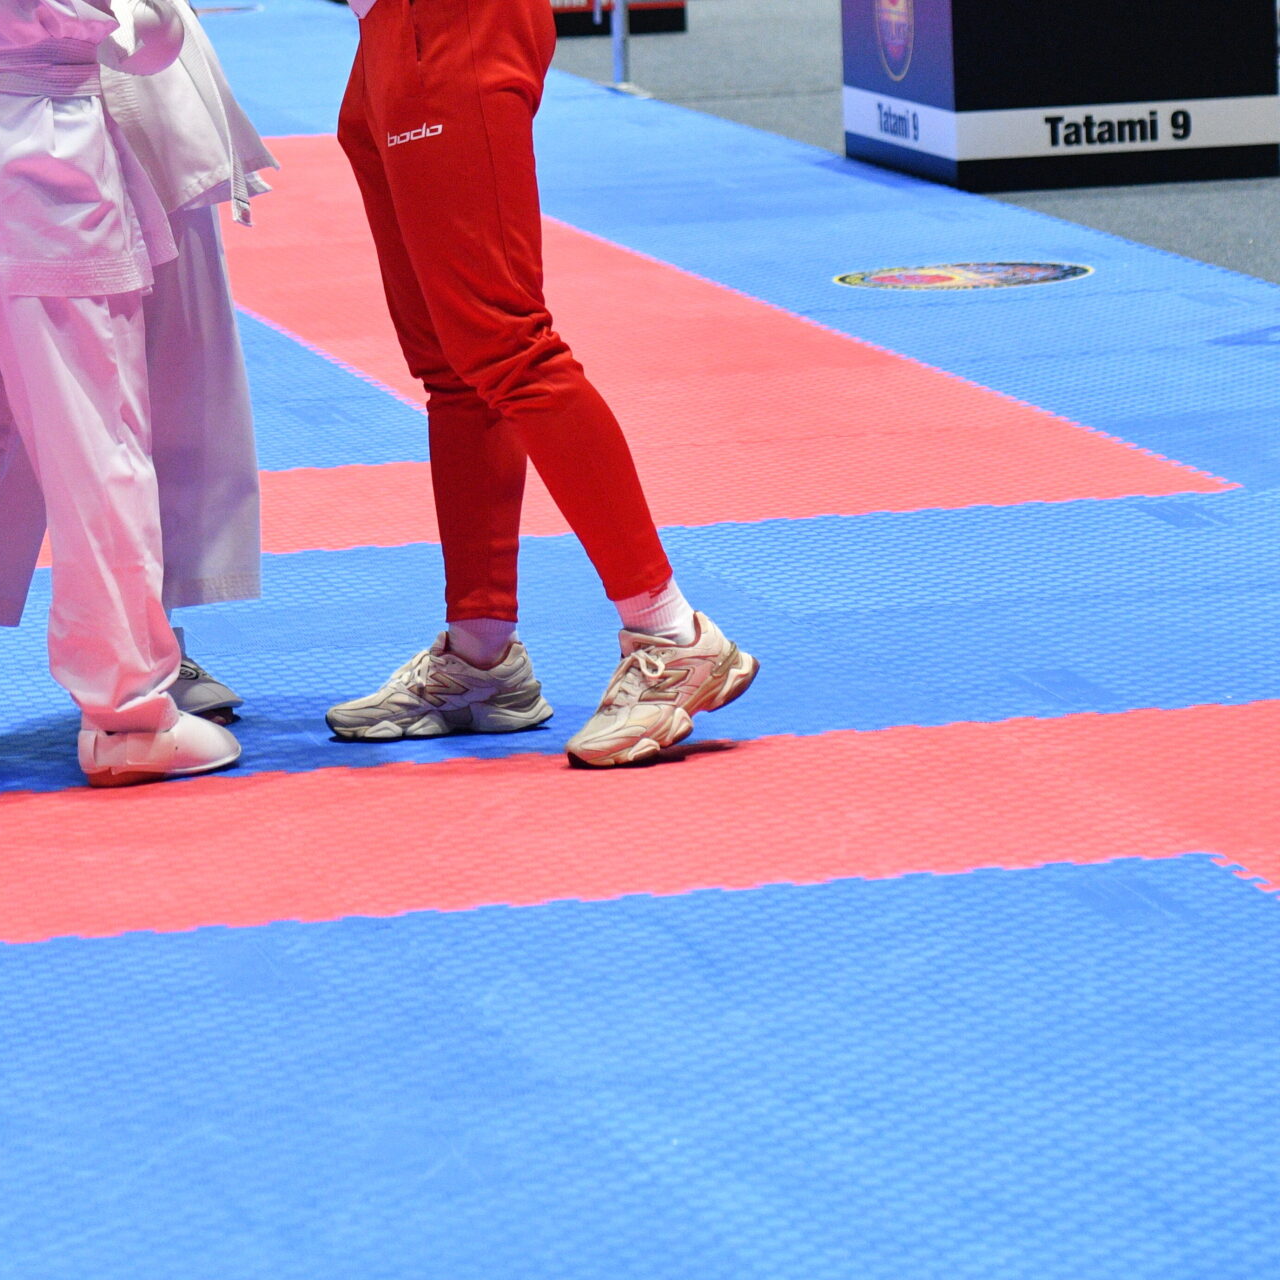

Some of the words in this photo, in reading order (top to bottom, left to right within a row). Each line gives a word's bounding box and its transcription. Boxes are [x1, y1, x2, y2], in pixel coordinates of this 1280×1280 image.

[387, 122, 443, 148] bodo
[877, 102, 910, 139] Tatami
[912, 112, 919, 141] 9
[1045, 110, 1159, 147] Tatami
[1170, 109, 1192, 140] 9
